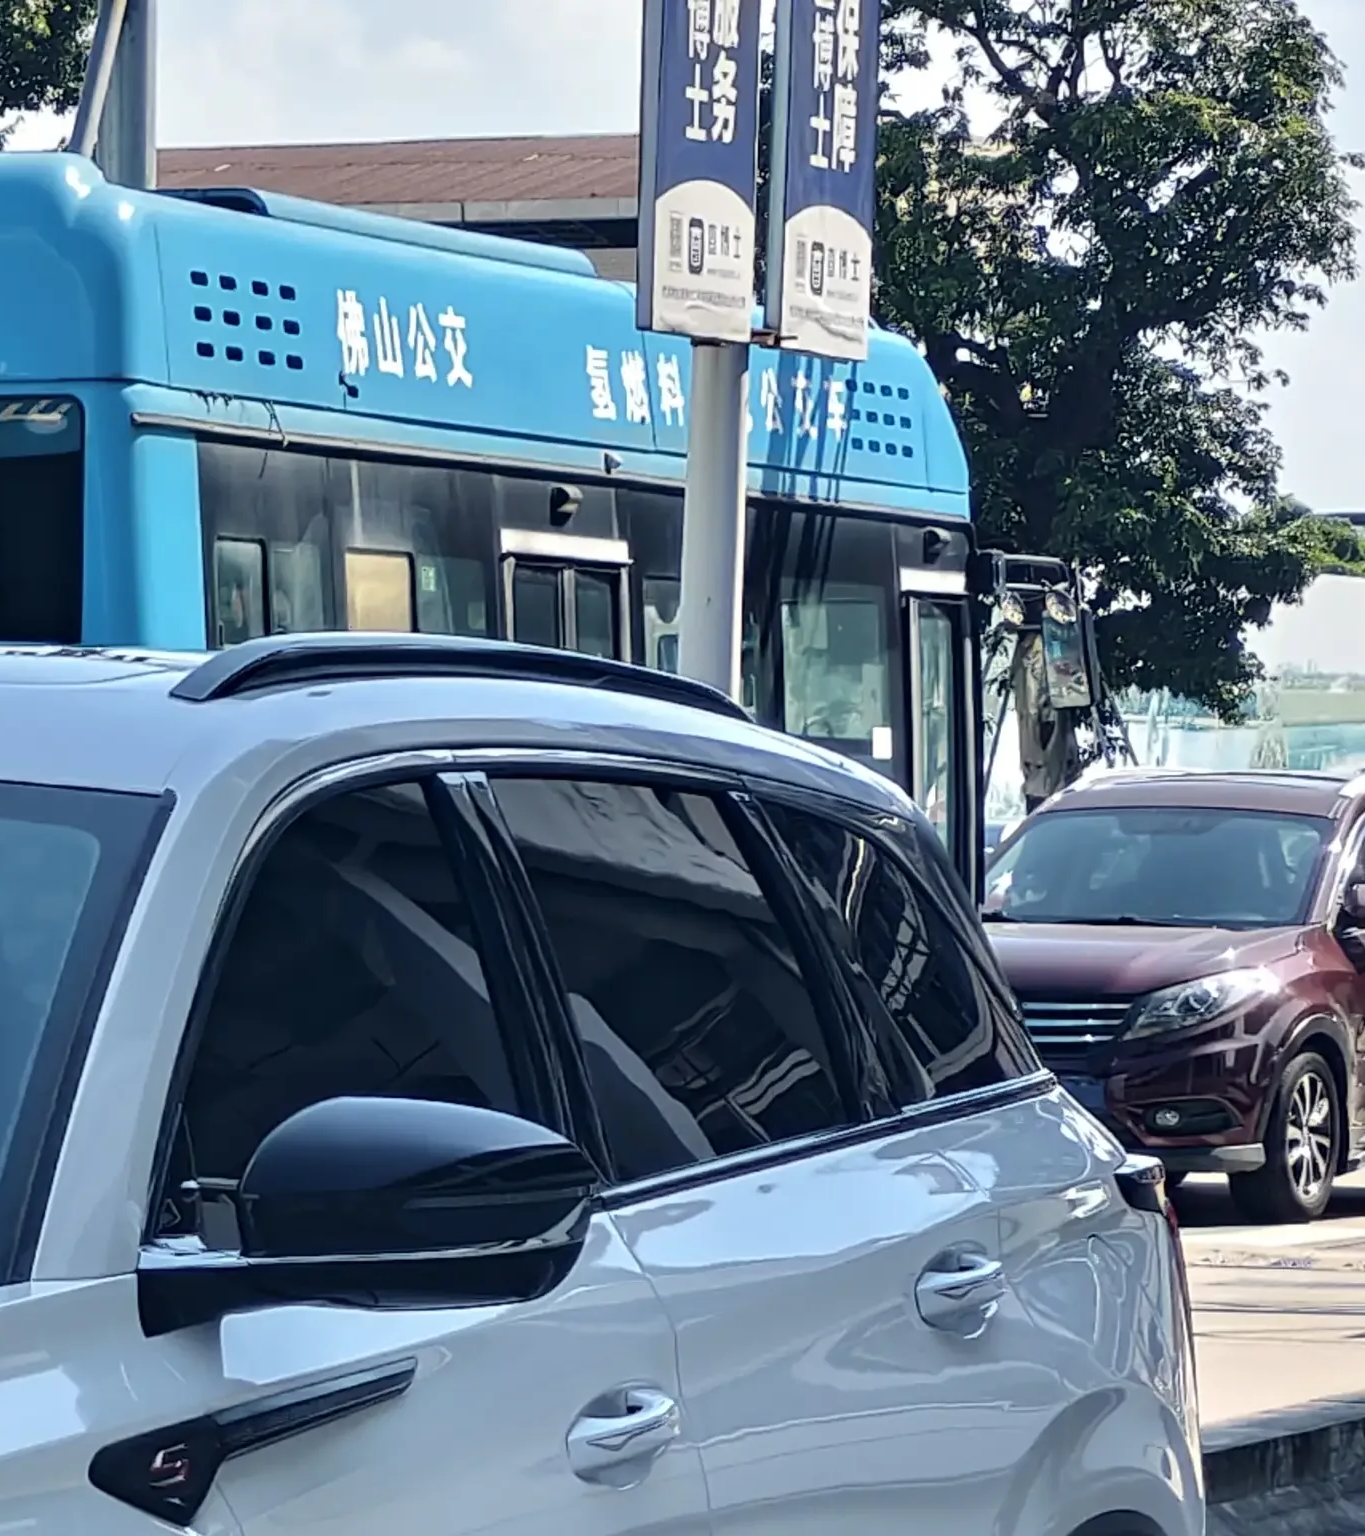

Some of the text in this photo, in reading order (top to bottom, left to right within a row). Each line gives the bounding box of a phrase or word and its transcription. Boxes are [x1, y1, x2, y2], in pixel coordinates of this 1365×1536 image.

[809, 0, 836, 169] 博士
[336, 288, 474, 388] 佛山公交
[586, 345, 848, 441] 氢燃料公交车
